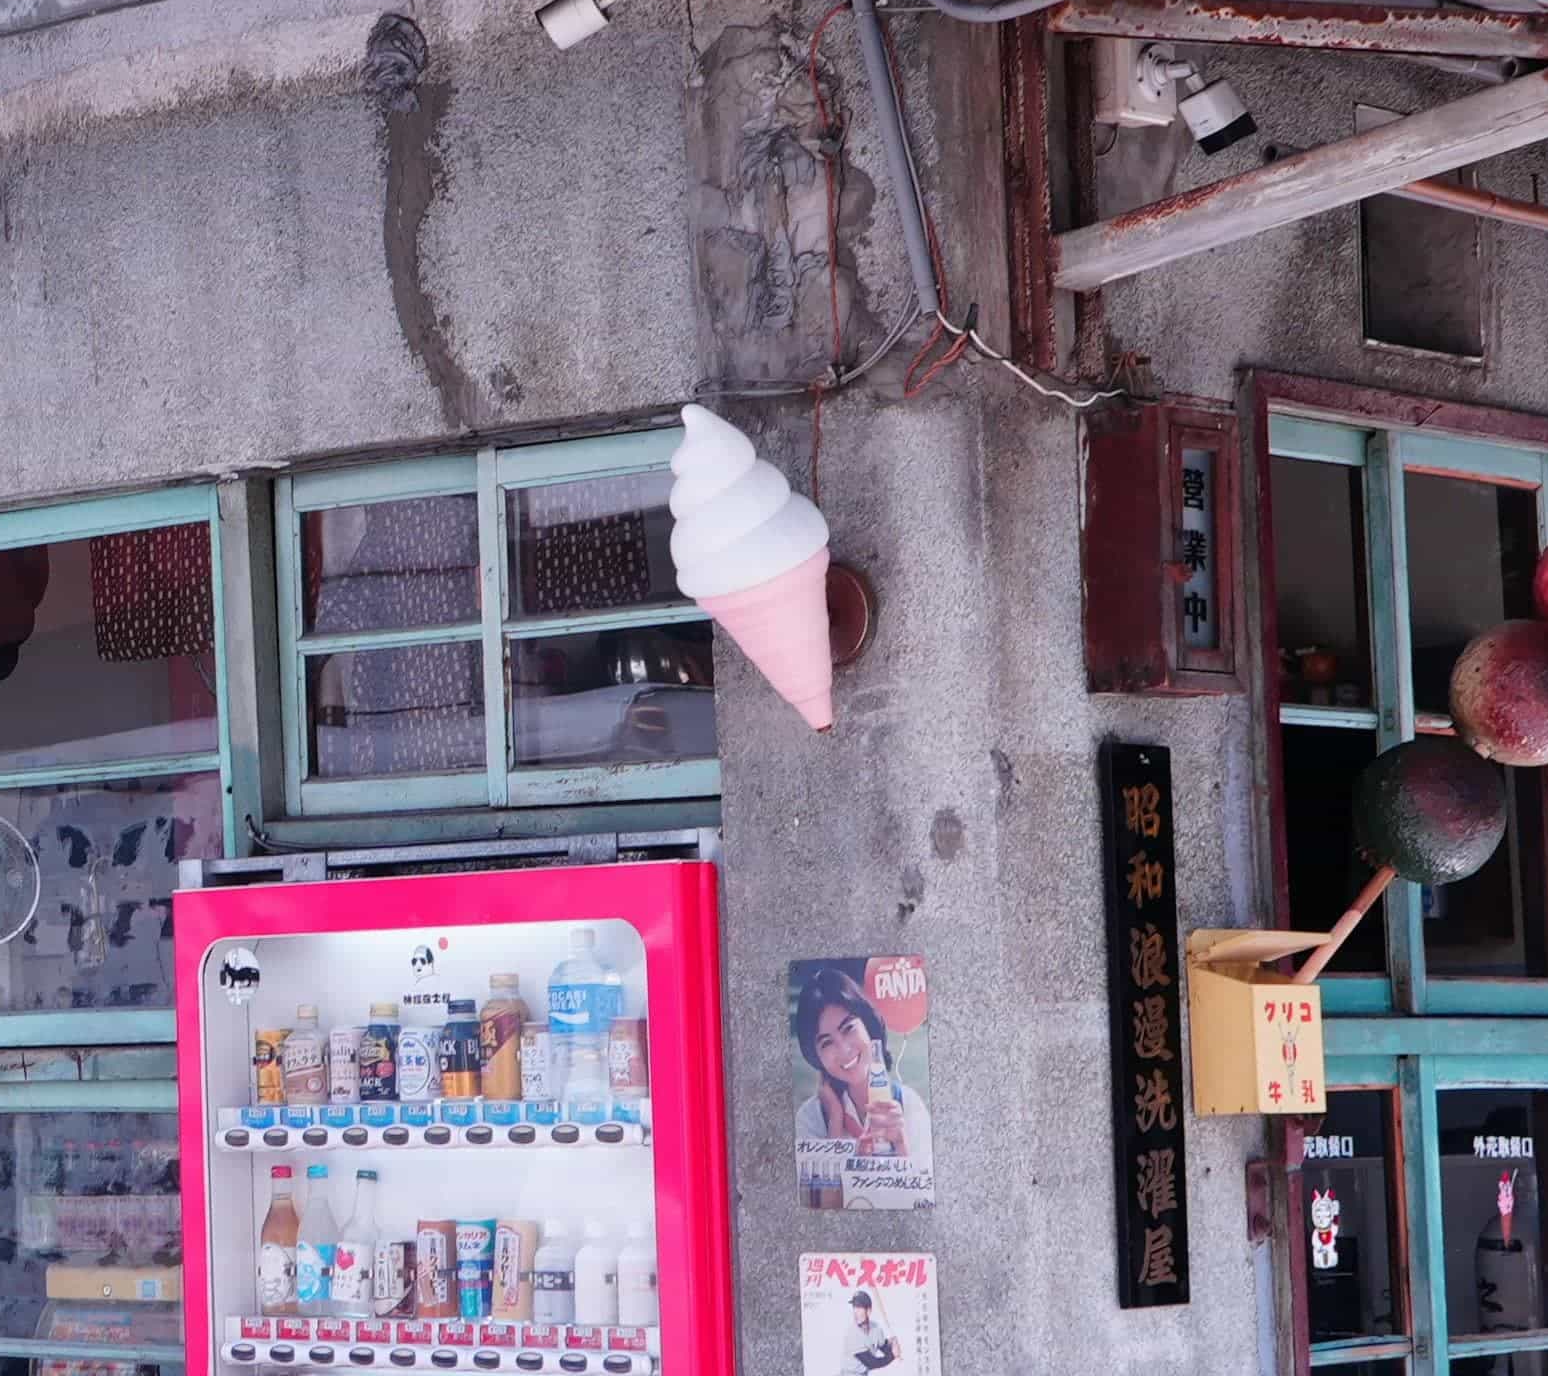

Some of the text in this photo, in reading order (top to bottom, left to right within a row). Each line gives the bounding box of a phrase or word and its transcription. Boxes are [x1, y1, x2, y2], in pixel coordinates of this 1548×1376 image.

[1123, 783, 1178, 1286] 昭和浪漫洗濯屋
[826, 1258, 928, 1288] ベースボール
